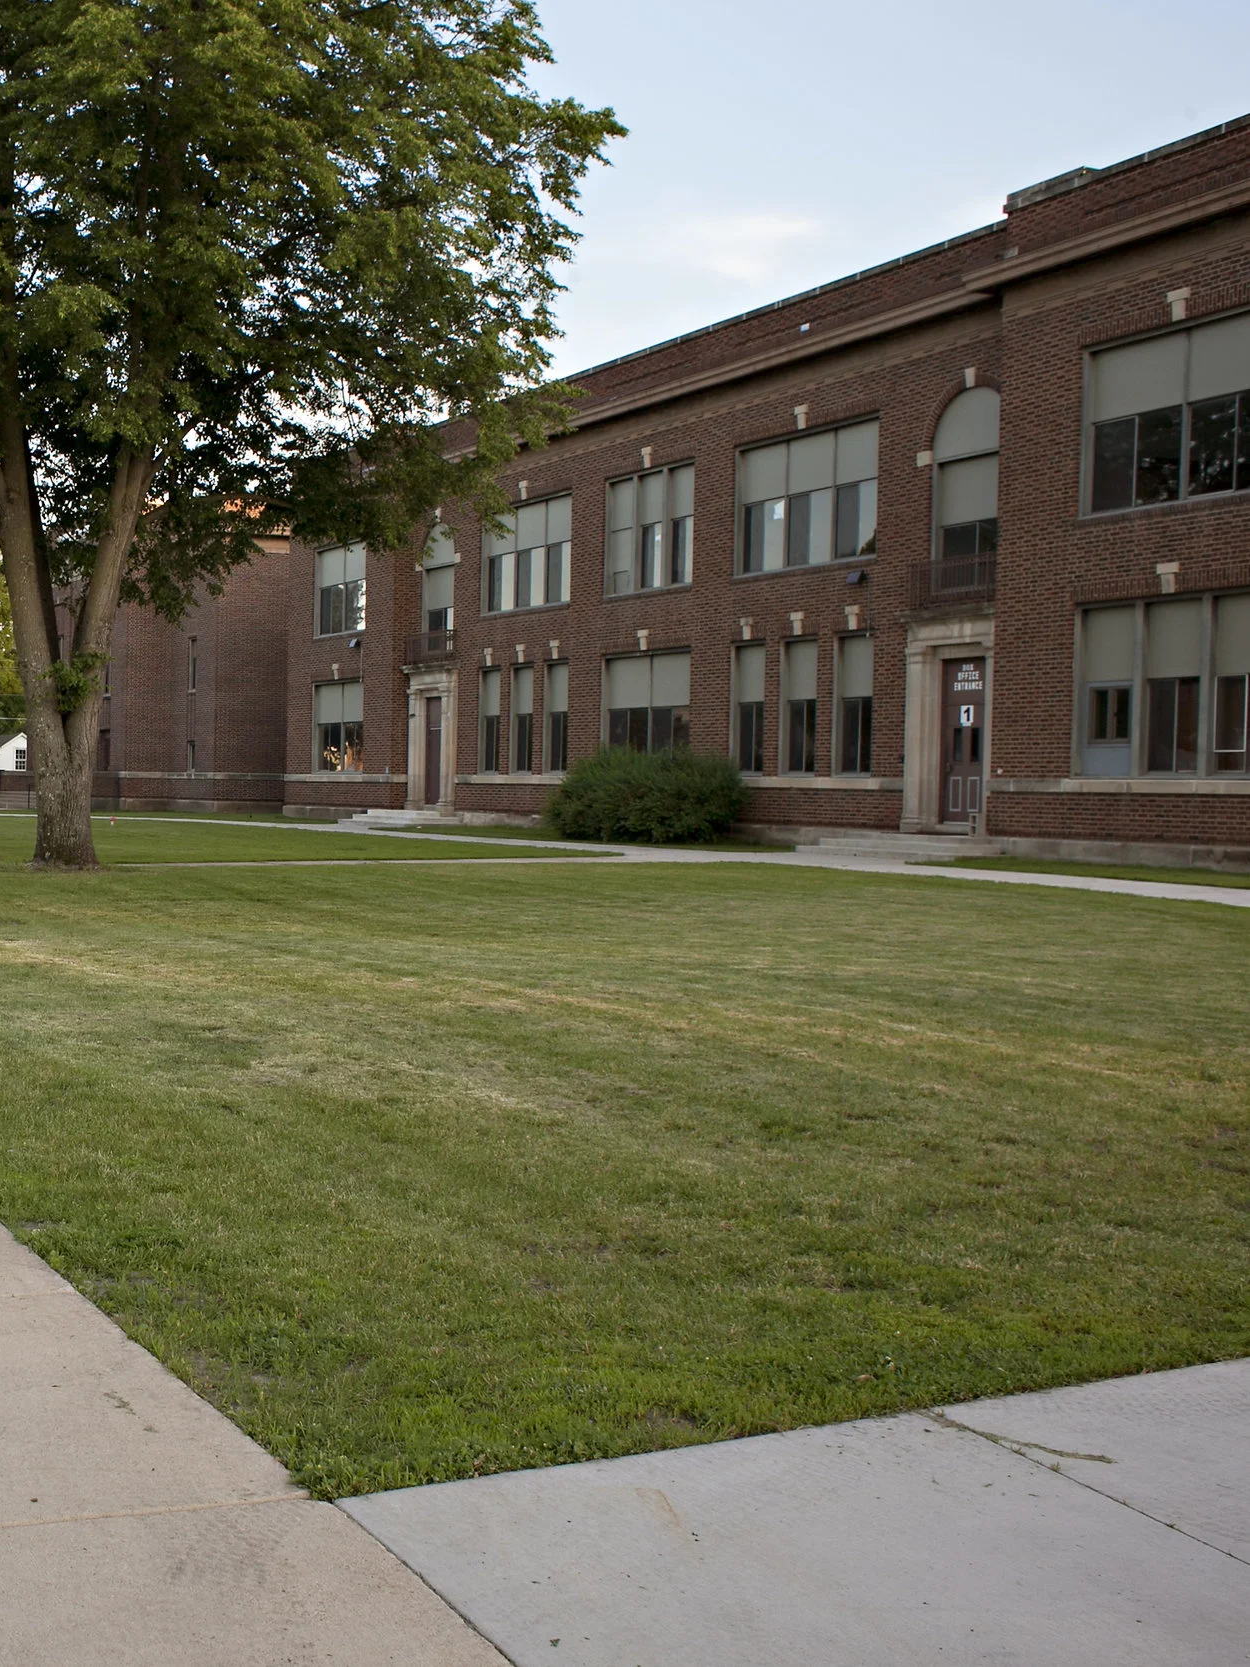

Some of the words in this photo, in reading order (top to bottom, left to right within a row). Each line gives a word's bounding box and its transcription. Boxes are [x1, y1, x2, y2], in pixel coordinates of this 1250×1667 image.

[957, 672, 979, 680] OFFICE
[954, 681, 982, 690] ENTRANCE
[964, 707, 971, 722] 1
